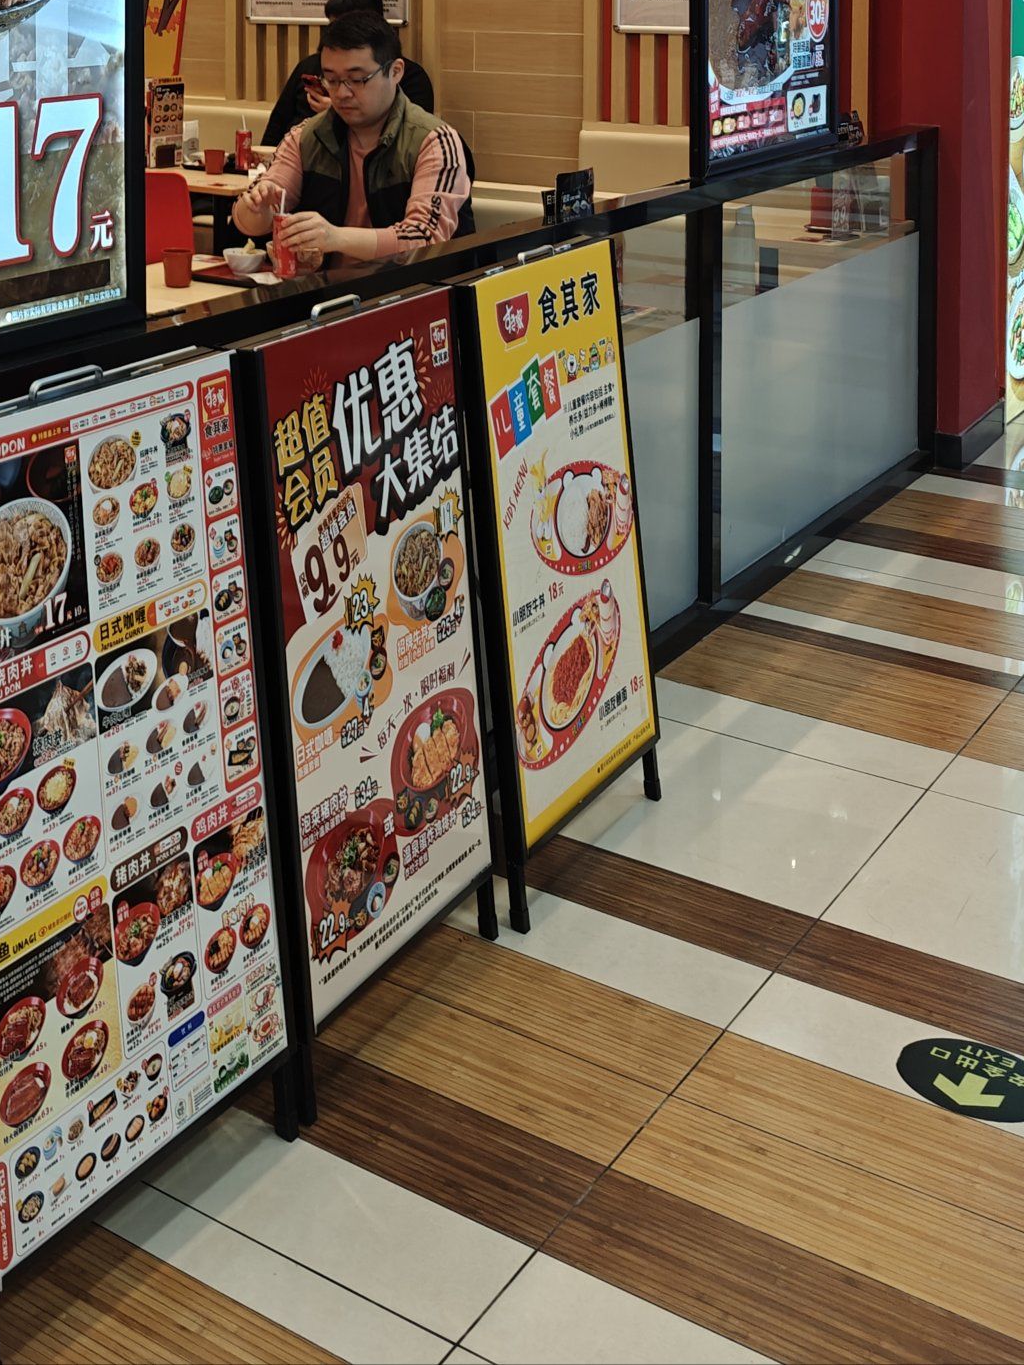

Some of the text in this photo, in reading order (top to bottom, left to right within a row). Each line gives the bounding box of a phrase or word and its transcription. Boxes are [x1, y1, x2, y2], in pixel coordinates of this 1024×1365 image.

[537, 270, 601, 335] 食其家
[332, 337, 423, 475] 优惠
[494, 365, 559, 437] 儿童套餐
[203, 417, 230, 439] 食其家
[274, 392, 331, 476] 超值
[376, 404, 459, 518] 大集结
[283, 446, 339, 527] 会员
[502, 456, 530, 532] KIDS MENU
[319, 498, 357, 554] 超值会员
[99, 605, 146, 642] 日式咖喱
[124, 625, 145, 641] CURRY
[512, 592, 547, 628] 小朋友牛丼
[4, 681, 22, 698] DON
[295, 725, 335, 767] 日式咖喱
[195, 802, 229, 836] 鸡肉丼
[300, 784, 349, 834] 泡菜猪肉丼
[382, 811, 395, 838] 或
[401, 806, 458, 868] 温泉蛋炸鸡排丼
[114, 850, 152, 888] 猪肉丼
[959, 1044, 1018, 1069] EXIT
